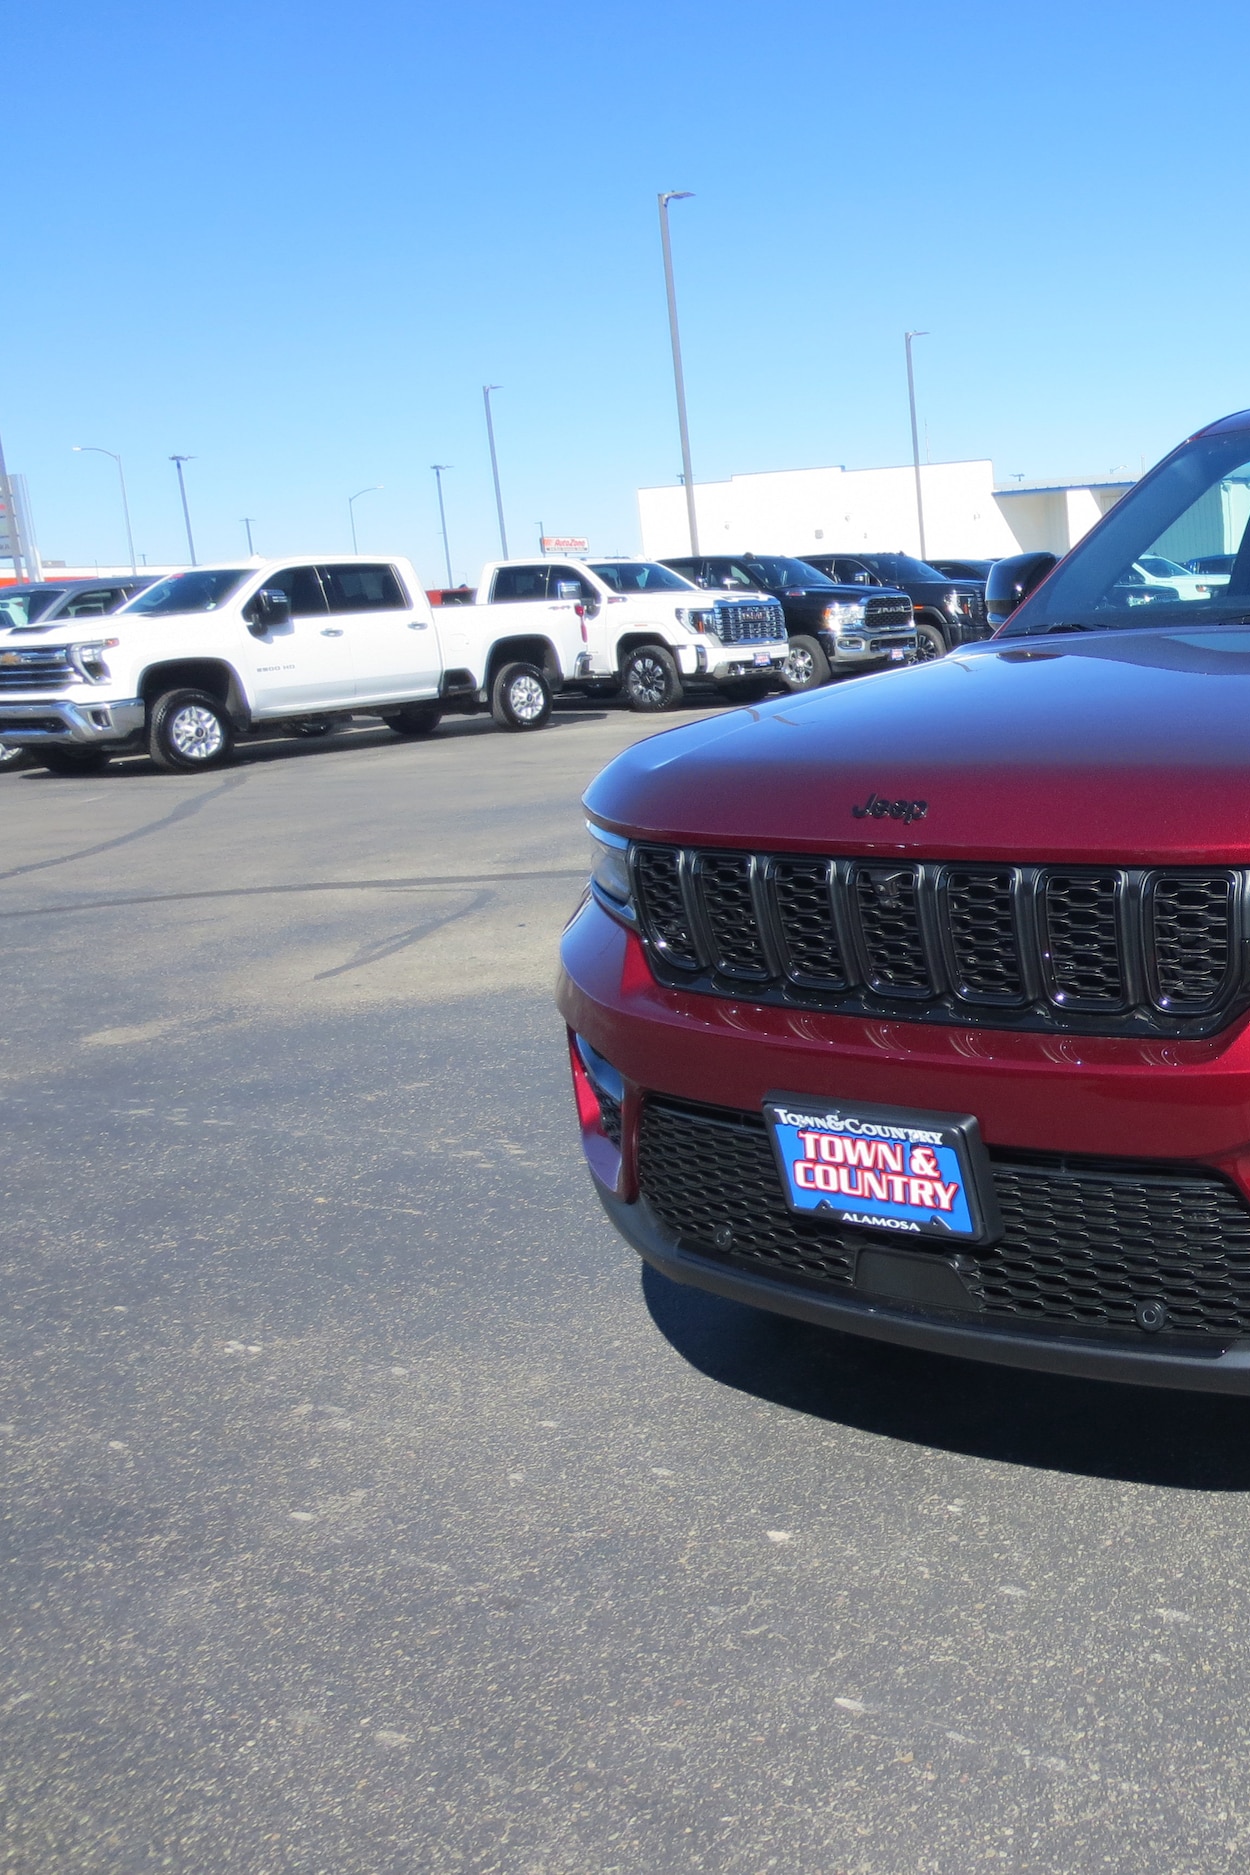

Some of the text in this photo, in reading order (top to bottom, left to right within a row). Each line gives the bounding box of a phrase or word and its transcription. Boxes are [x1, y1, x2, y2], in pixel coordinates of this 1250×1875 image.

[852, 793, 928, 825] Jeep
[797, 1130, 941, 1179] TOWN &
[793, 1160, 959, 1212] COUNTRY
[842, 1212, 921, 1232] ALAMOSA
